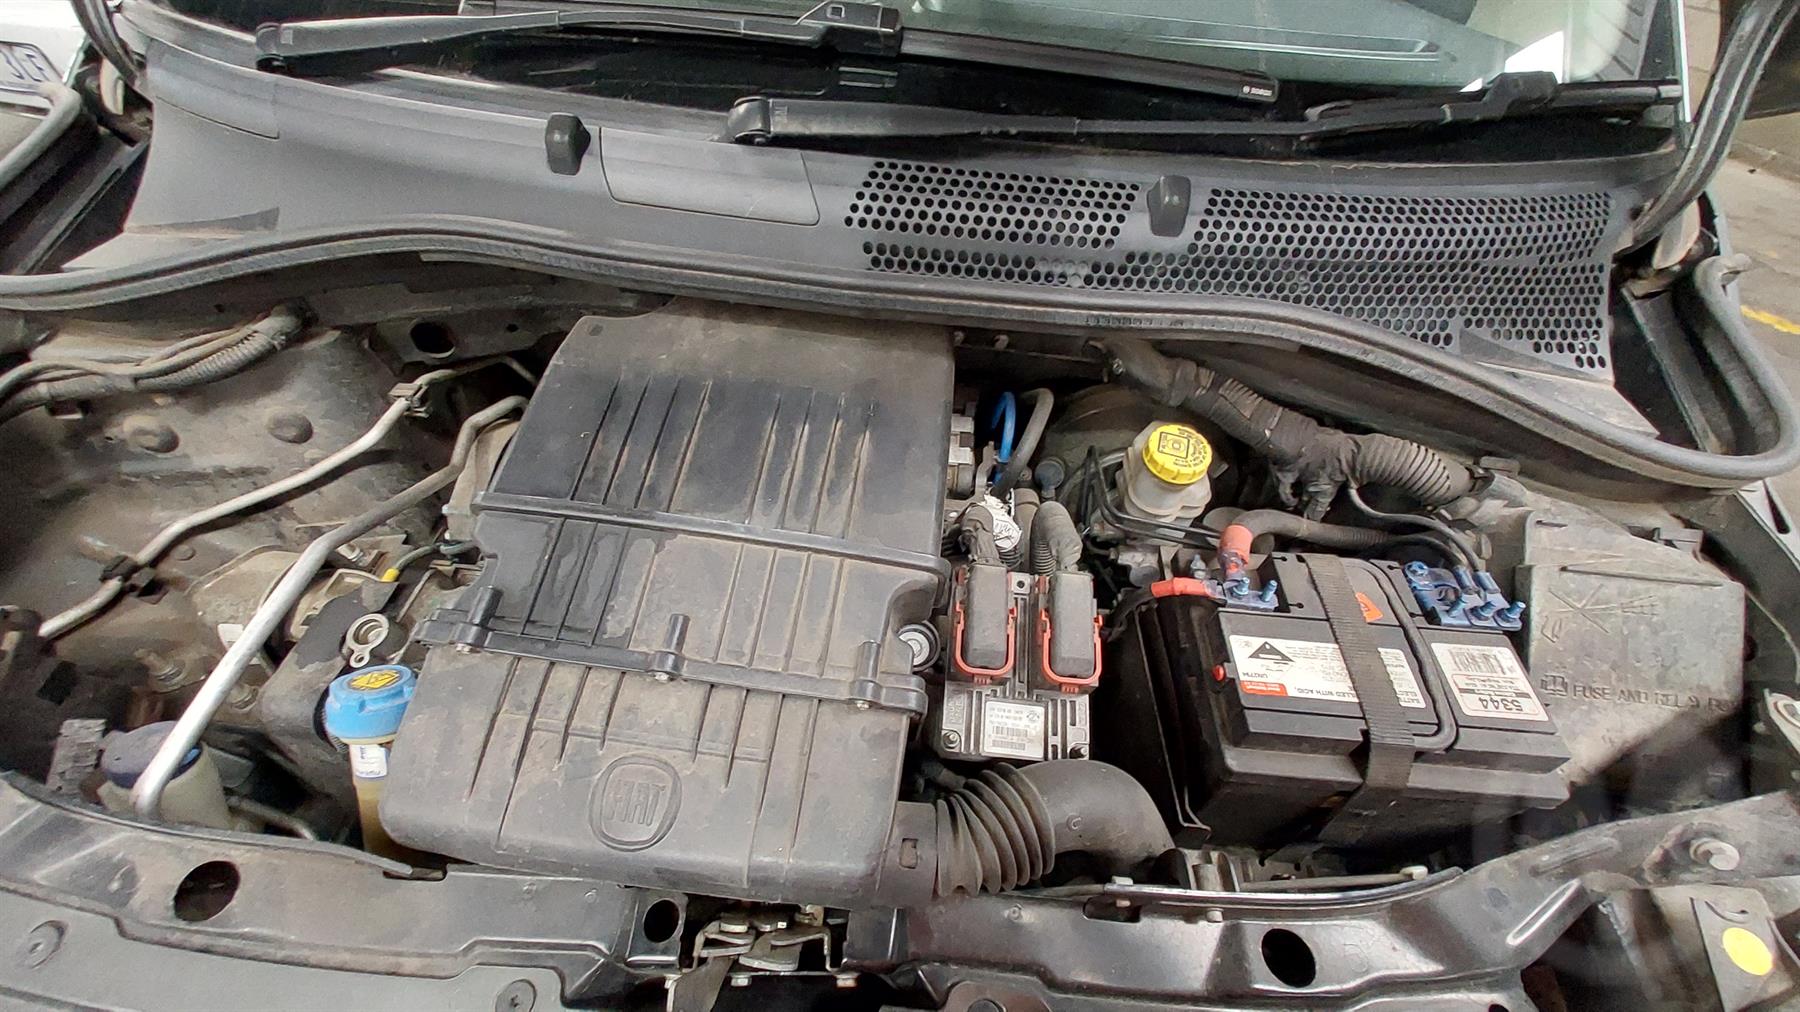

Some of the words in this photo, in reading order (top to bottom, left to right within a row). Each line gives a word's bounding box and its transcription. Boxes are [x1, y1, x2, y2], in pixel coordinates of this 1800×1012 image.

[1479, 697, 1523, 711] 5344
[1573, 684, 1611, 701] FUSE
[1617, 688, 1649, 704] AND
[605, 780, 667, 827] FIAT
